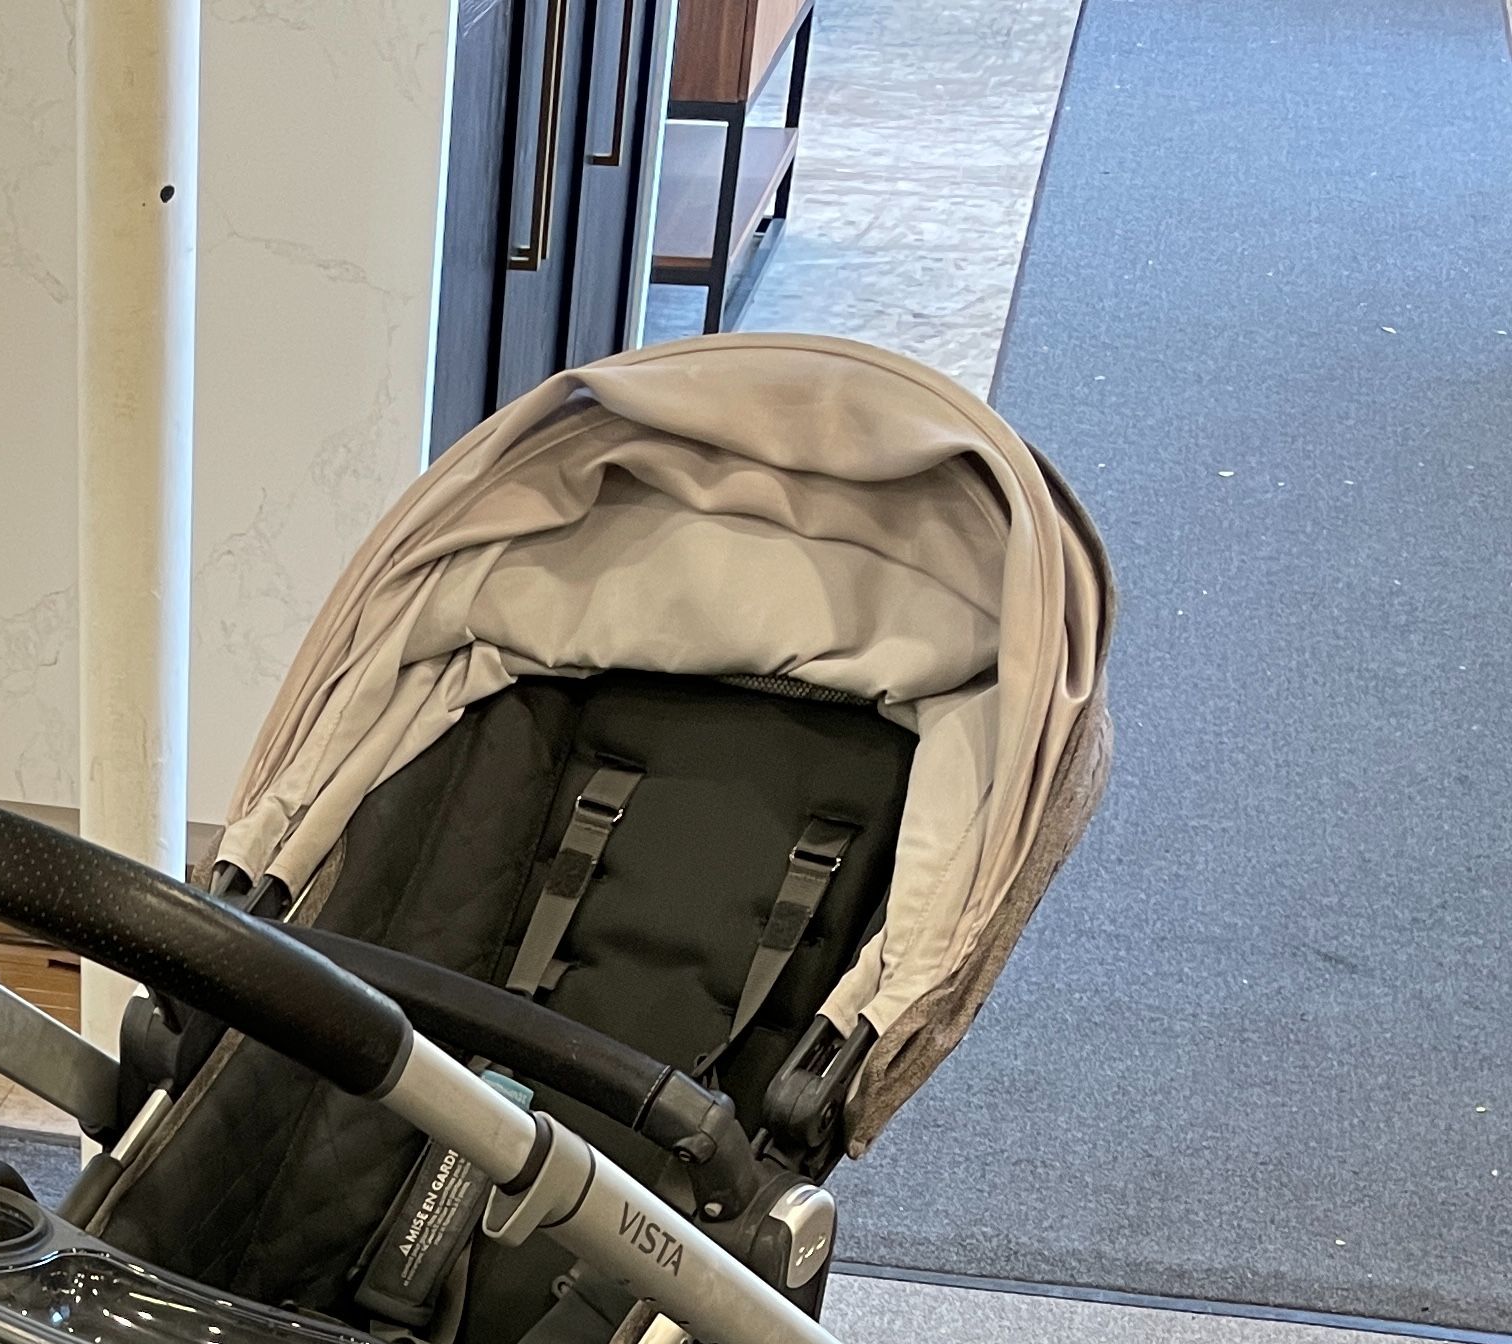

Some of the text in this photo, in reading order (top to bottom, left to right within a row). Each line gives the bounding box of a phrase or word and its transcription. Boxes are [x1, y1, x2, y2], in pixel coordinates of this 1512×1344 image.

[405, 1210, 428, 1243] MISE
[422, 1192, 438, 1214] EN
[619, 1201, 684, 1277] VISTA
